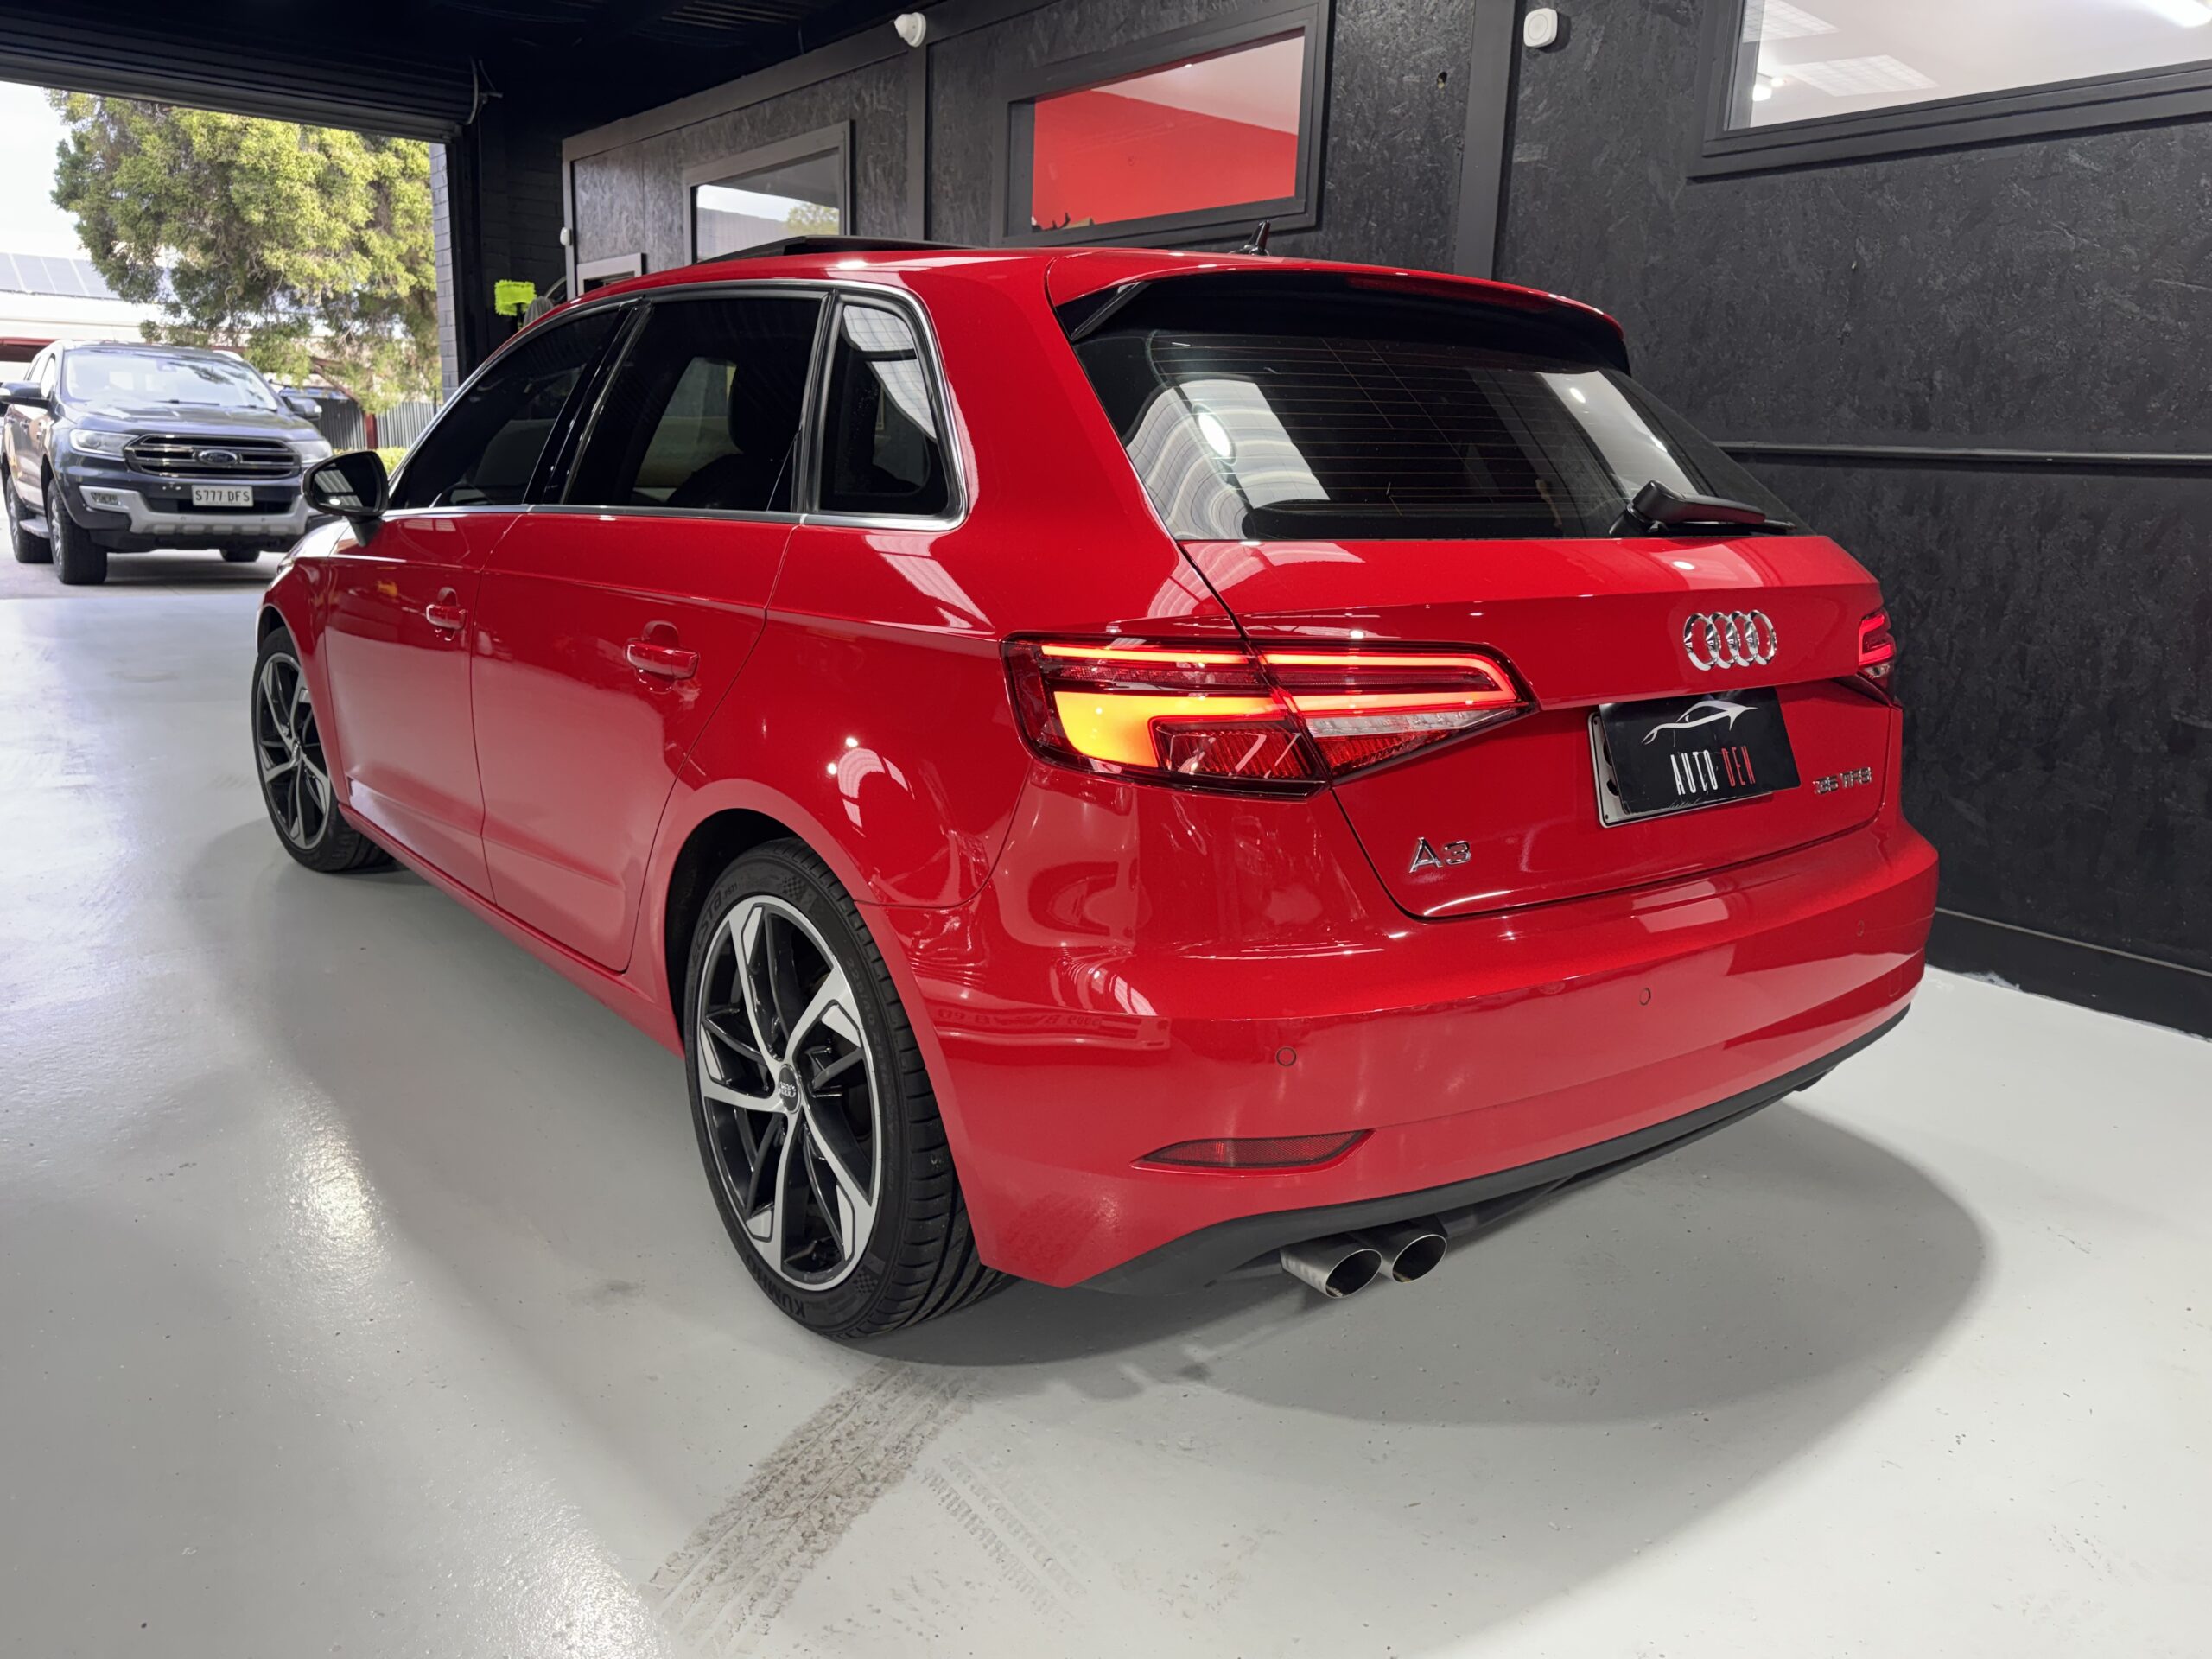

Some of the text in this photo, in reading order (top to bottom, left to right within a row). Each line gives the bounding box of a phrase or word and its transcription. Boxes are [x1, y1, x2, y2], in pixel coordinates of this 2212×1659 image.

[195, 490, 250, 502] S777 DFS
[1670, 745, 1756, 796] AUTO DEN
[1408, 836, 1471, 874] A3
[747, 1254, 806, 1319] KUMHO
